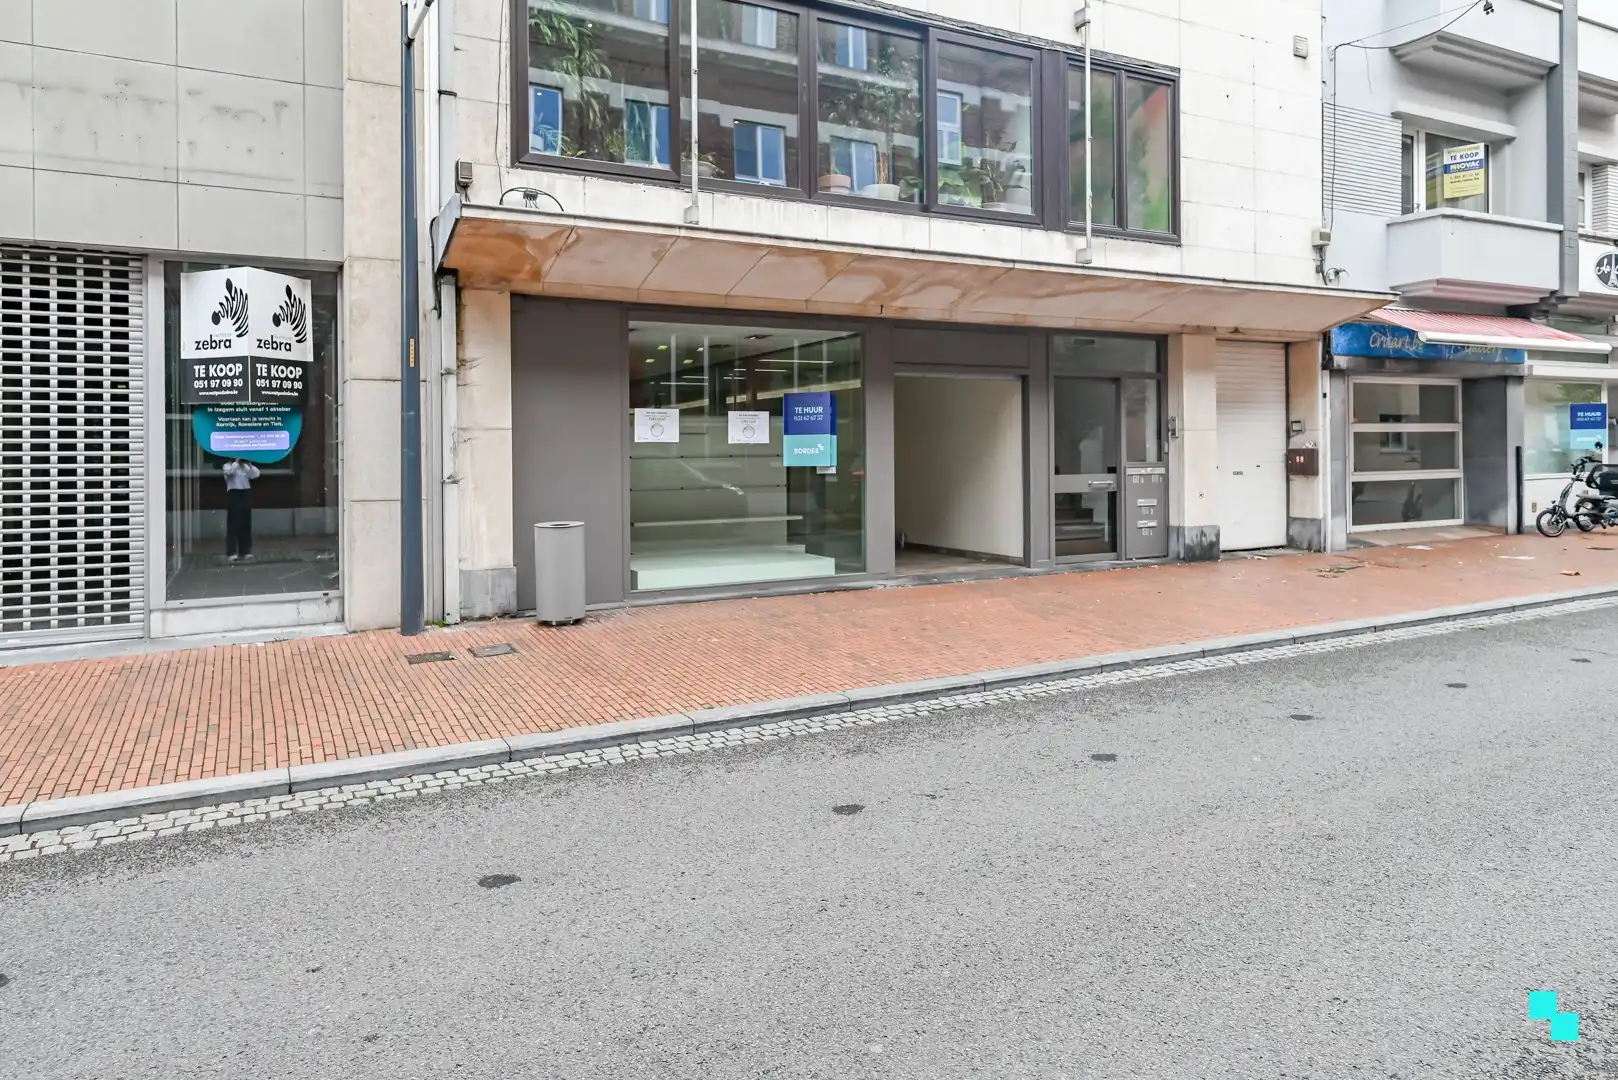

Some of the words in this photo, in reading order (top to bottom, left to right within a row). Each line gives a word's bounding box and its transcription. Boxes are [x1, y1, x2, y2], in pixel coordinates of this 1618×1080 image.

[194, 334, 232, 350] zebra
[256, 334, 292, 352] zebra
[194, 364, 206, 377] TE
[209, 363, 243, 377] KOOP
[256, 364, 267, 376] TE
[271, 364, 302, 379] KOOP
[194, 380, 208, 388] 051
[222, 379, 231, 387] 09
[233, 379, 243, 387] 90
[256, 379, 269, 387] 051
[272, 380, 280, 388] 97
[282, 381, 292, 389] 09
[293, 381, 302, 389] 90
